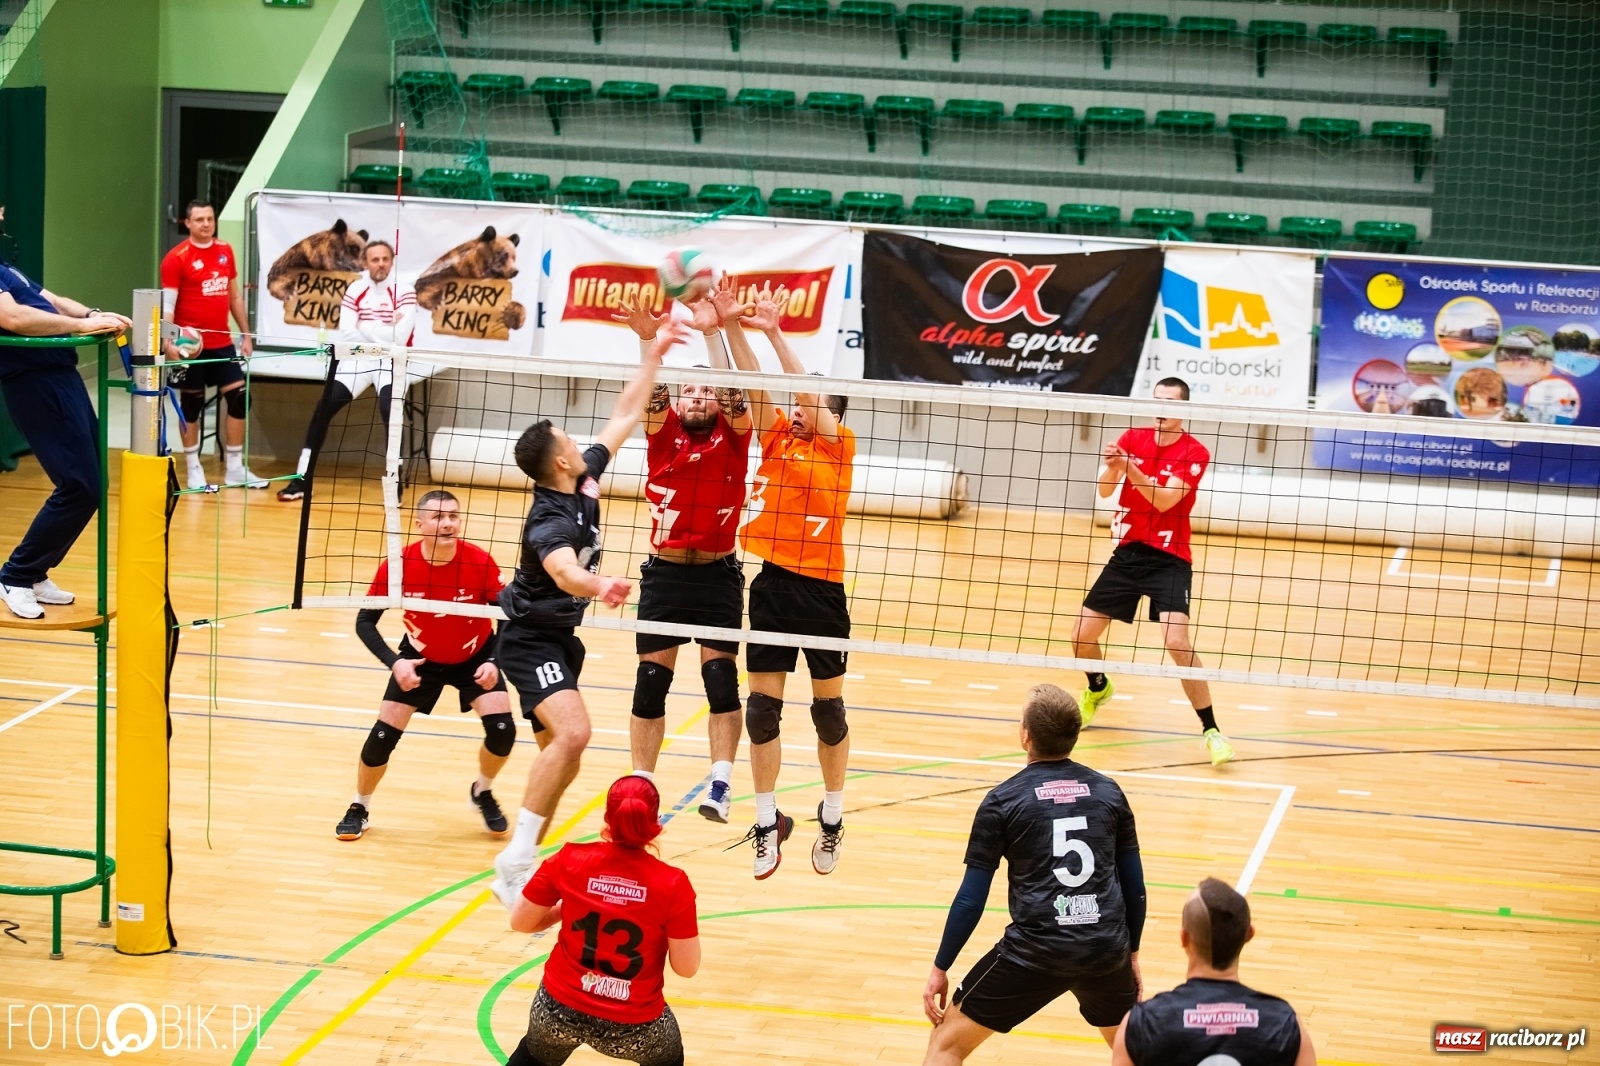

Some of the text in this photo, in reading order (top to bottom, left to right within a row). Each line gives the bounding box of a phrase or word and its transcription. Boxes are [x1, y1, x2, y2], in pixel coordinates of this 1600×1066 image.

[297, 272, 356, 298] BARRY
[444, 282, 505, 307] BARRY
[1419, 275, 1600, 300] Ośrodek Sportu i Rekreacji
[293, 299, 341, 329] KING
[1514, 300, 1599, 316] w Raciborzu
[441, 308, 491, 338] KING
[920, 322, 1099, 357] alpha spirit
[953, 350, 1064, 373] wild and perfect
[1176, 356, 1282, 378] raciborski
[1225, 382, 1281, 398] kultur
[1350, 451, 1511, 473] www.aquapark.raciborz.pl
[535, 661, 565, 690] 18
[1039, 786, 1086, 797] PIWIARNIA
[1052, 816, 1095, 888] 5
[591, 881, 642, 898] PIWIARNIA
[571, 910, 644, 980] 13
[1189, 1012, 1253, 1024] PIWIARNIA
